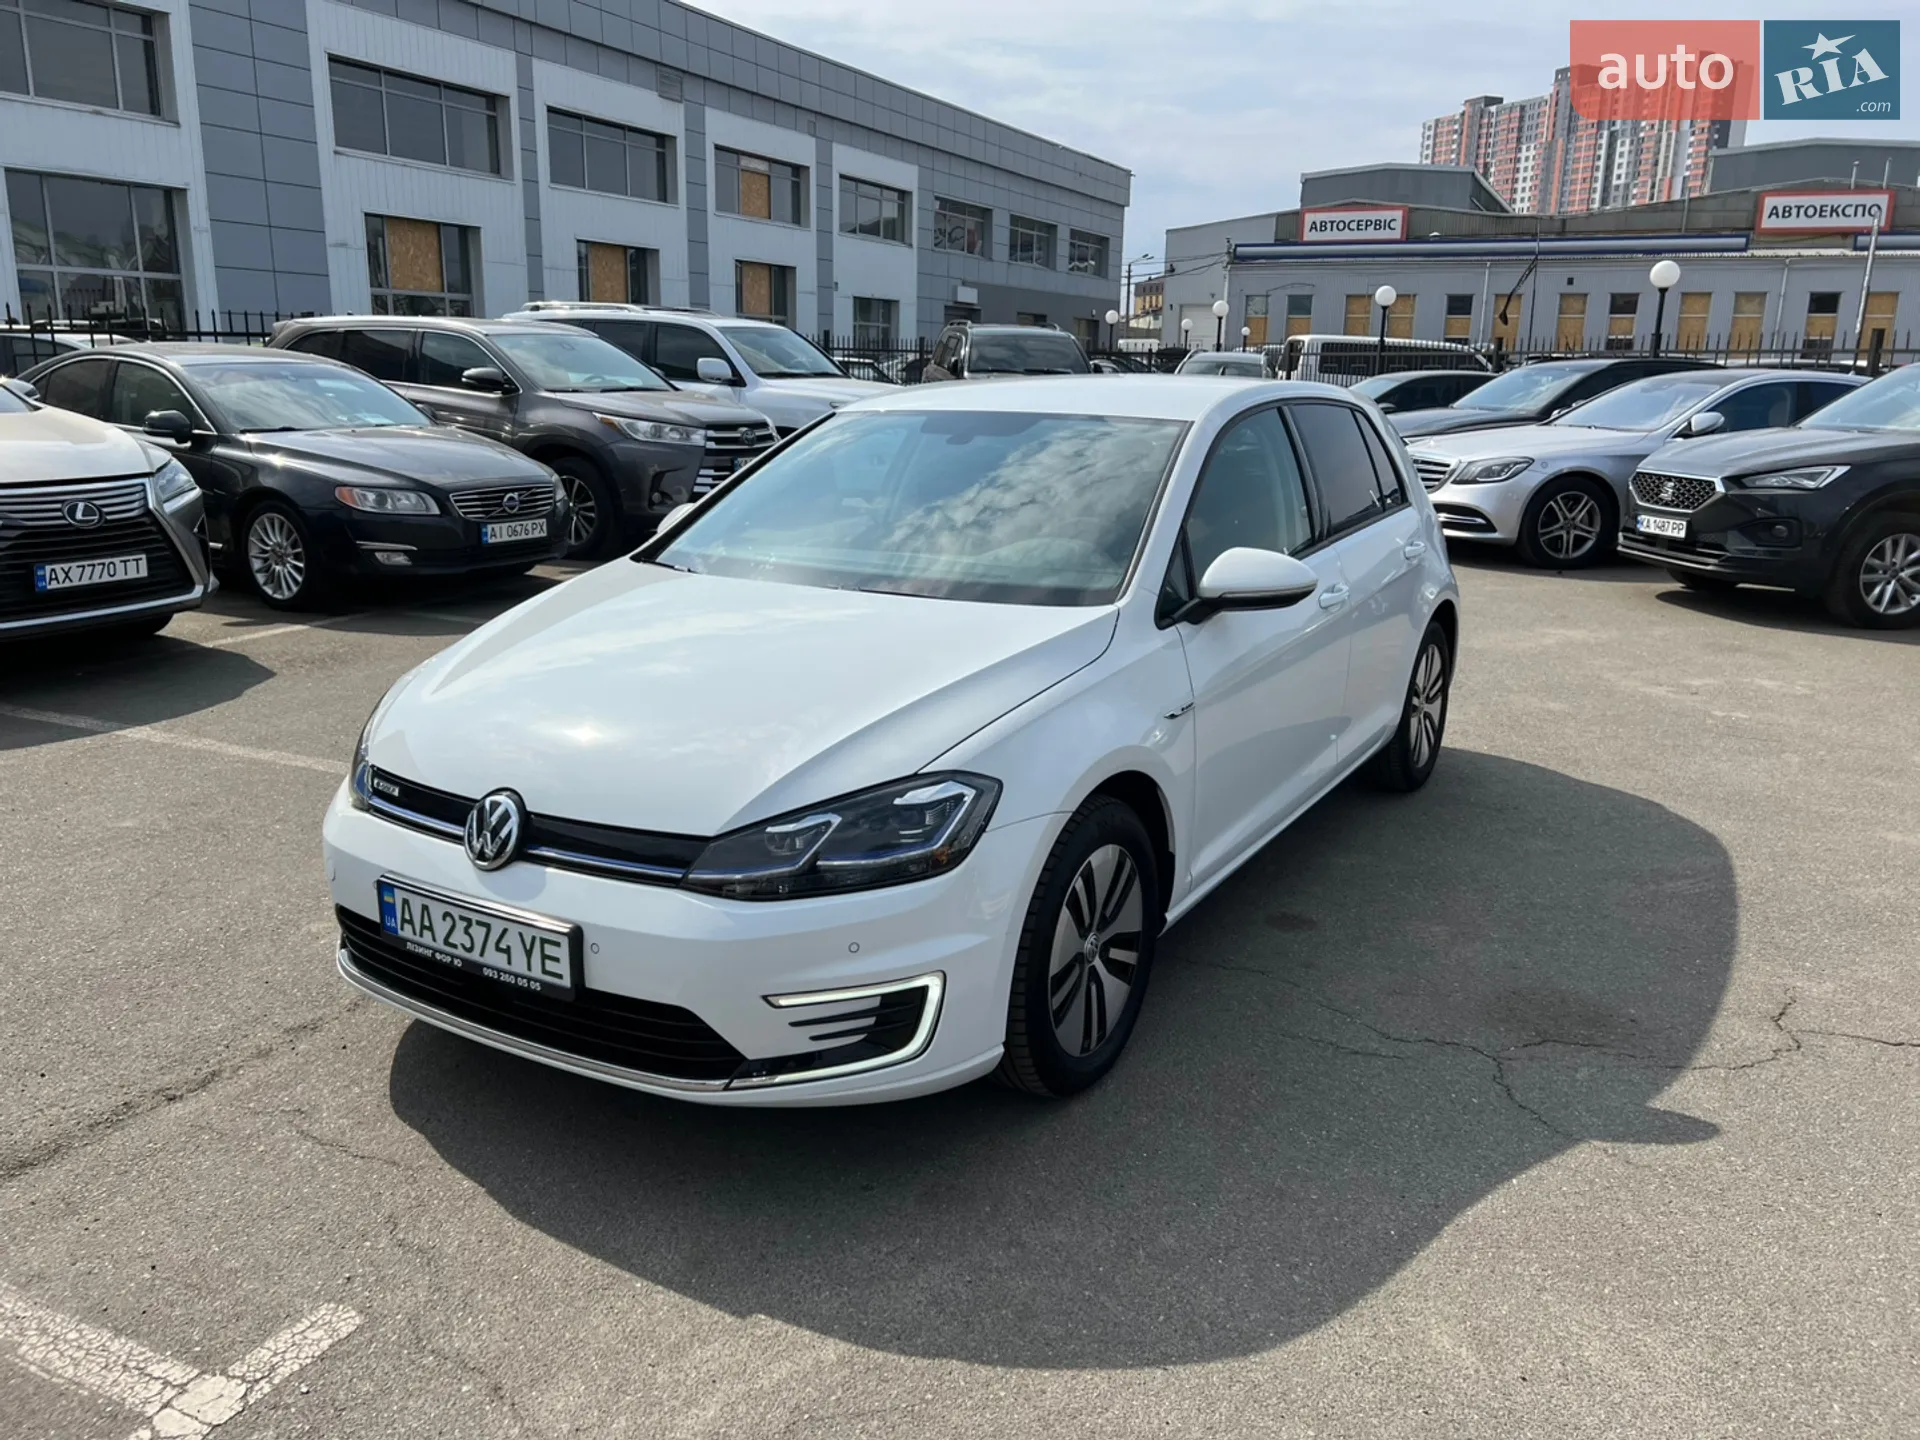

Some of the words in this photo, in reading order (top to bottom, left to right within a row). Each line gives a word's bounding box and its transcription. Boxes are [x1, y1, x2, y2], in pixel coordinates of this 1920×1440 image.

[1767, 203, 1883, 220] АВТОЕКСПО
[1308, 218, 1398, 233] АВТОСЕРВІС
[385, 914, 397, 929] UA
